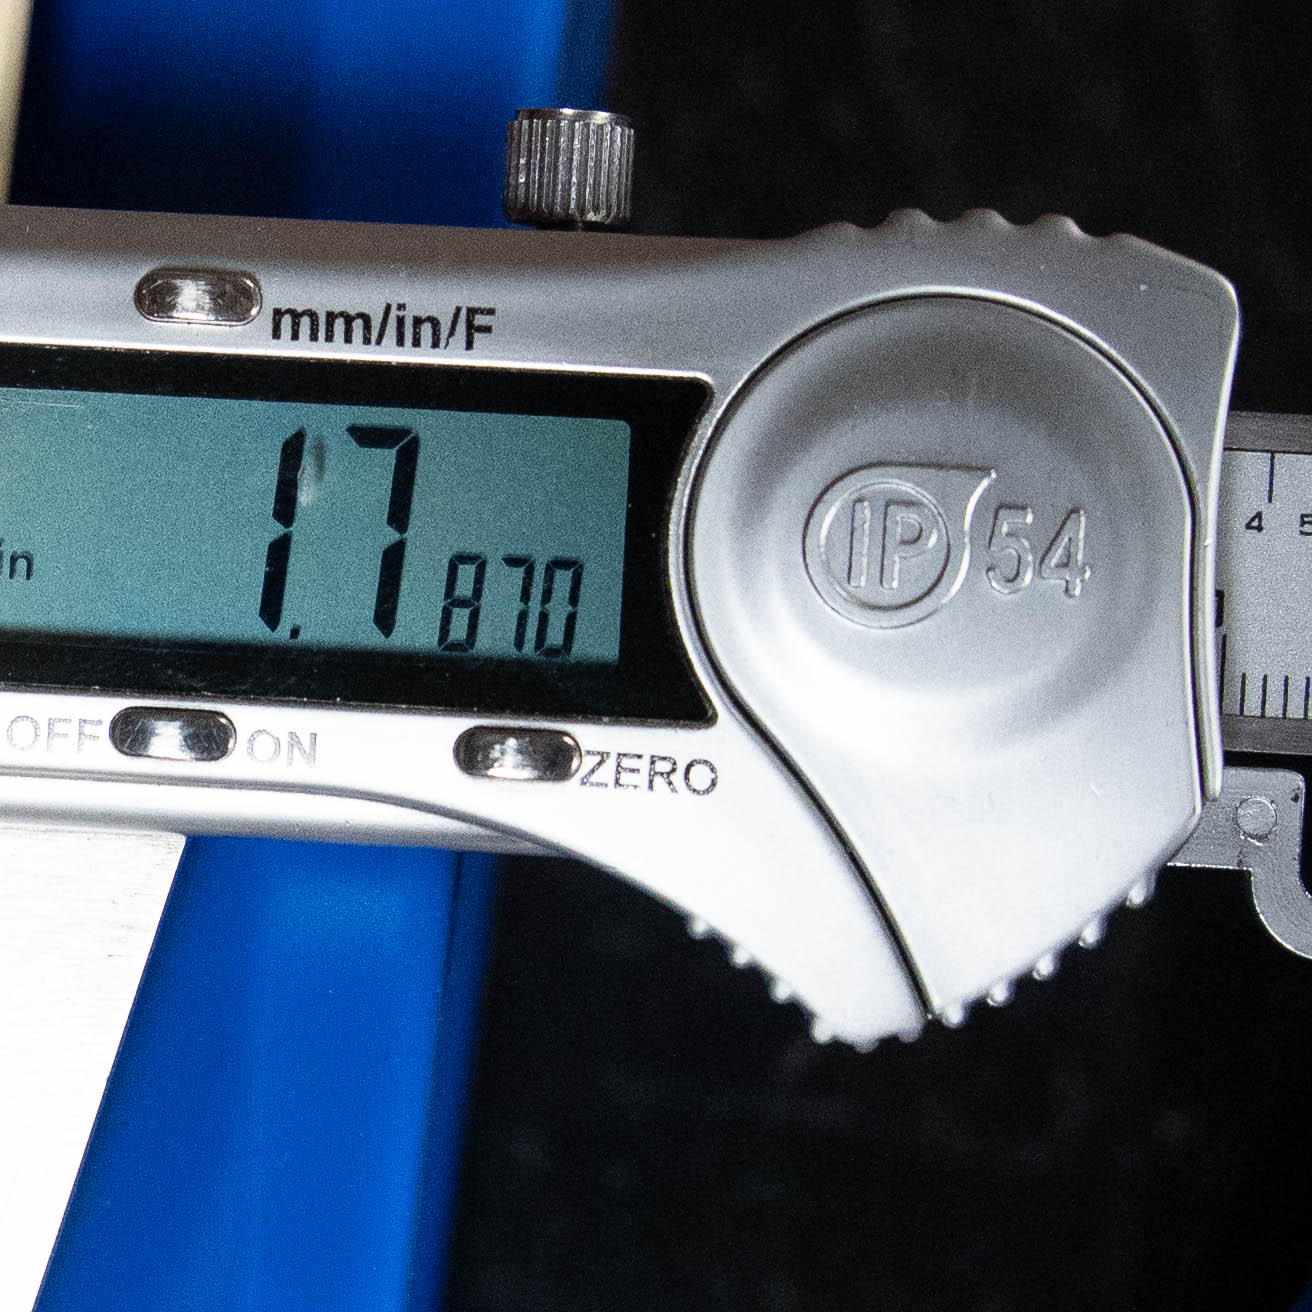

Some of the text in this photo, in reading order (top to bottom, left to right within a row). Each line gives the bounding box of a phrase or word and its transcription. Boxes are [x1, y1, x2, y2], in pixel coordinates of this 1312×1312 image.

[271, 302, 497, 351] mm/in/F
[1244, 511, 1264, 533] 4
[845, 497, 1092, 599] IP 54
[6, 715, 103, 754] OFF
[246, 729, 318, 768] ON
[580, 750, 718, 795] ZERO
